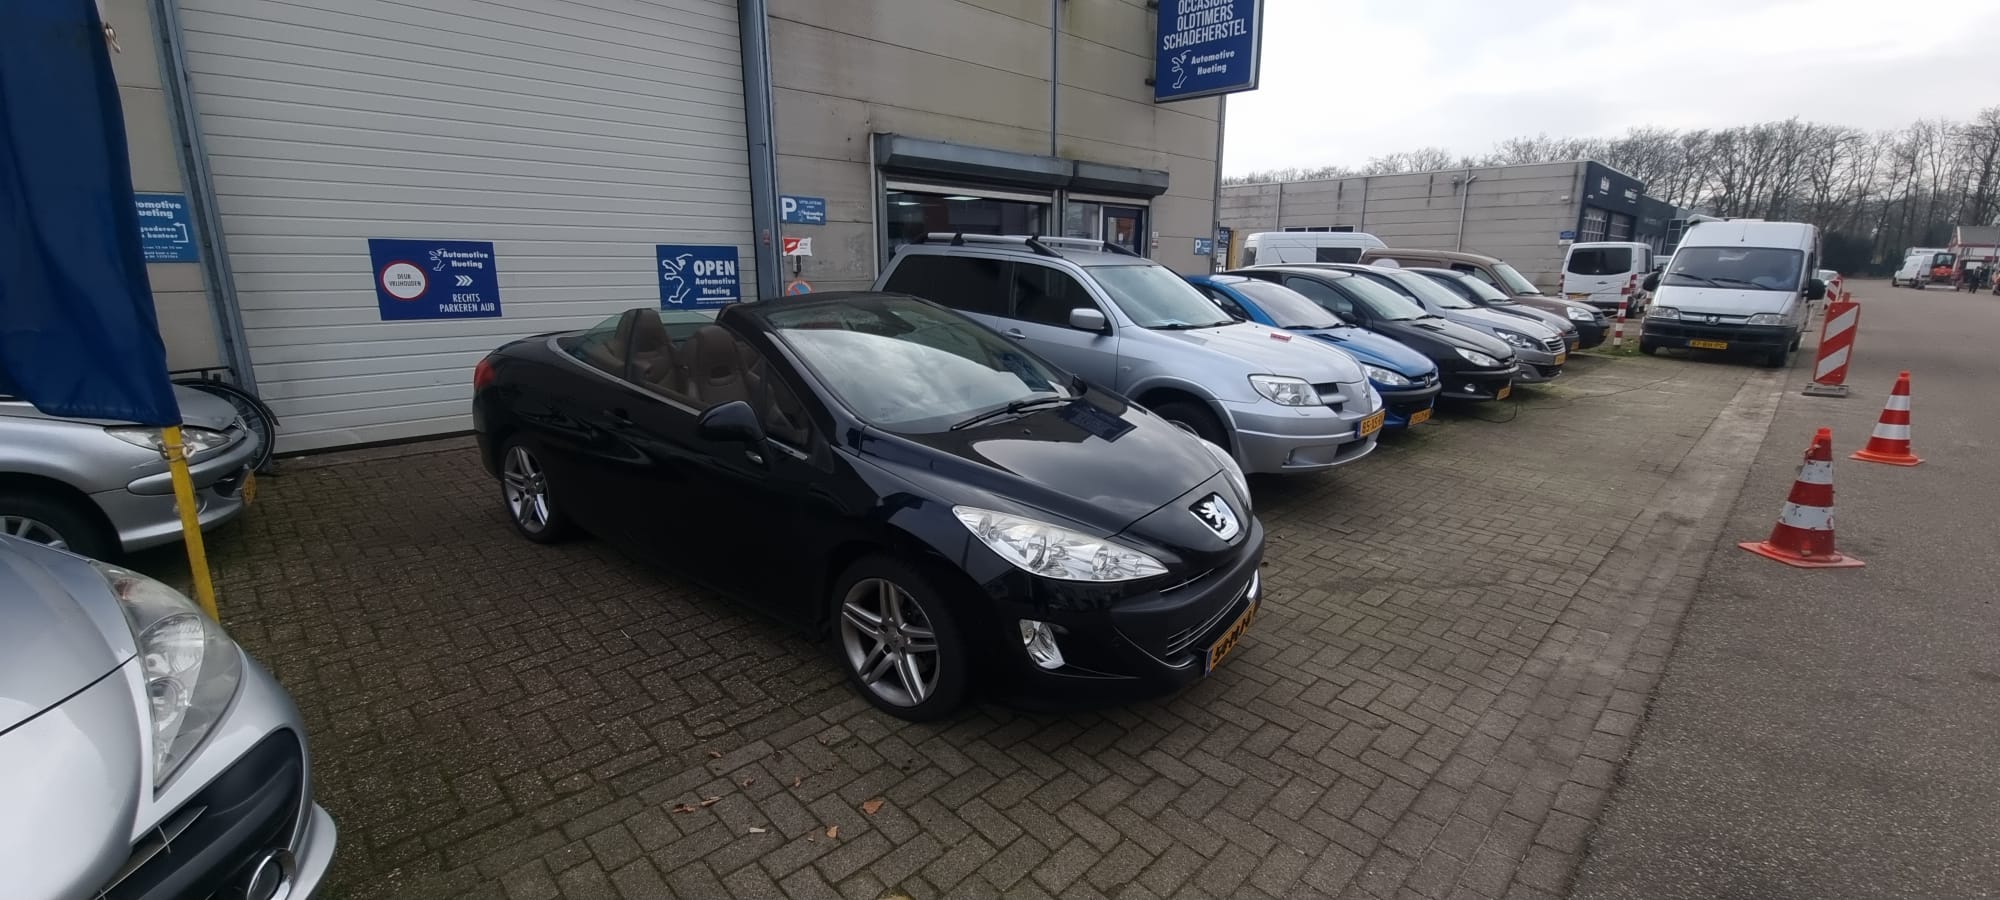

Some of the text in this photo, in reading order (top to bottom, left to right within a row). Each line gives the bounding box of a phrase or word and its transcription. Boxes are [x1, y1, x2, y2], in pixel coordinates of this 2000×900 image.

[1177, 0, 1234, 15] OCCASI
[1177, 4, 1234, 31] OLDTIMERS
[1163, 18, 1247, 50] SCHADEHERSTEL
[1191, 49, 1235, 65] Automotive
[1197, 63, 1227, 75] Hueting
[138, 209, 174, 219] ueting
[781, 197, 797, 220] P
[443, 250, 489, 259] Automotive
[451, 260, 483, 269] Hueting
[693, 260, 735, 276] OPEN
[695, 277, 736, 285] Automotive
[702, 286, 731, 296] Hueting
[452, 293, 480, 303] RECHTS
[440, 302, 495, 313] PARKEREN AUB
